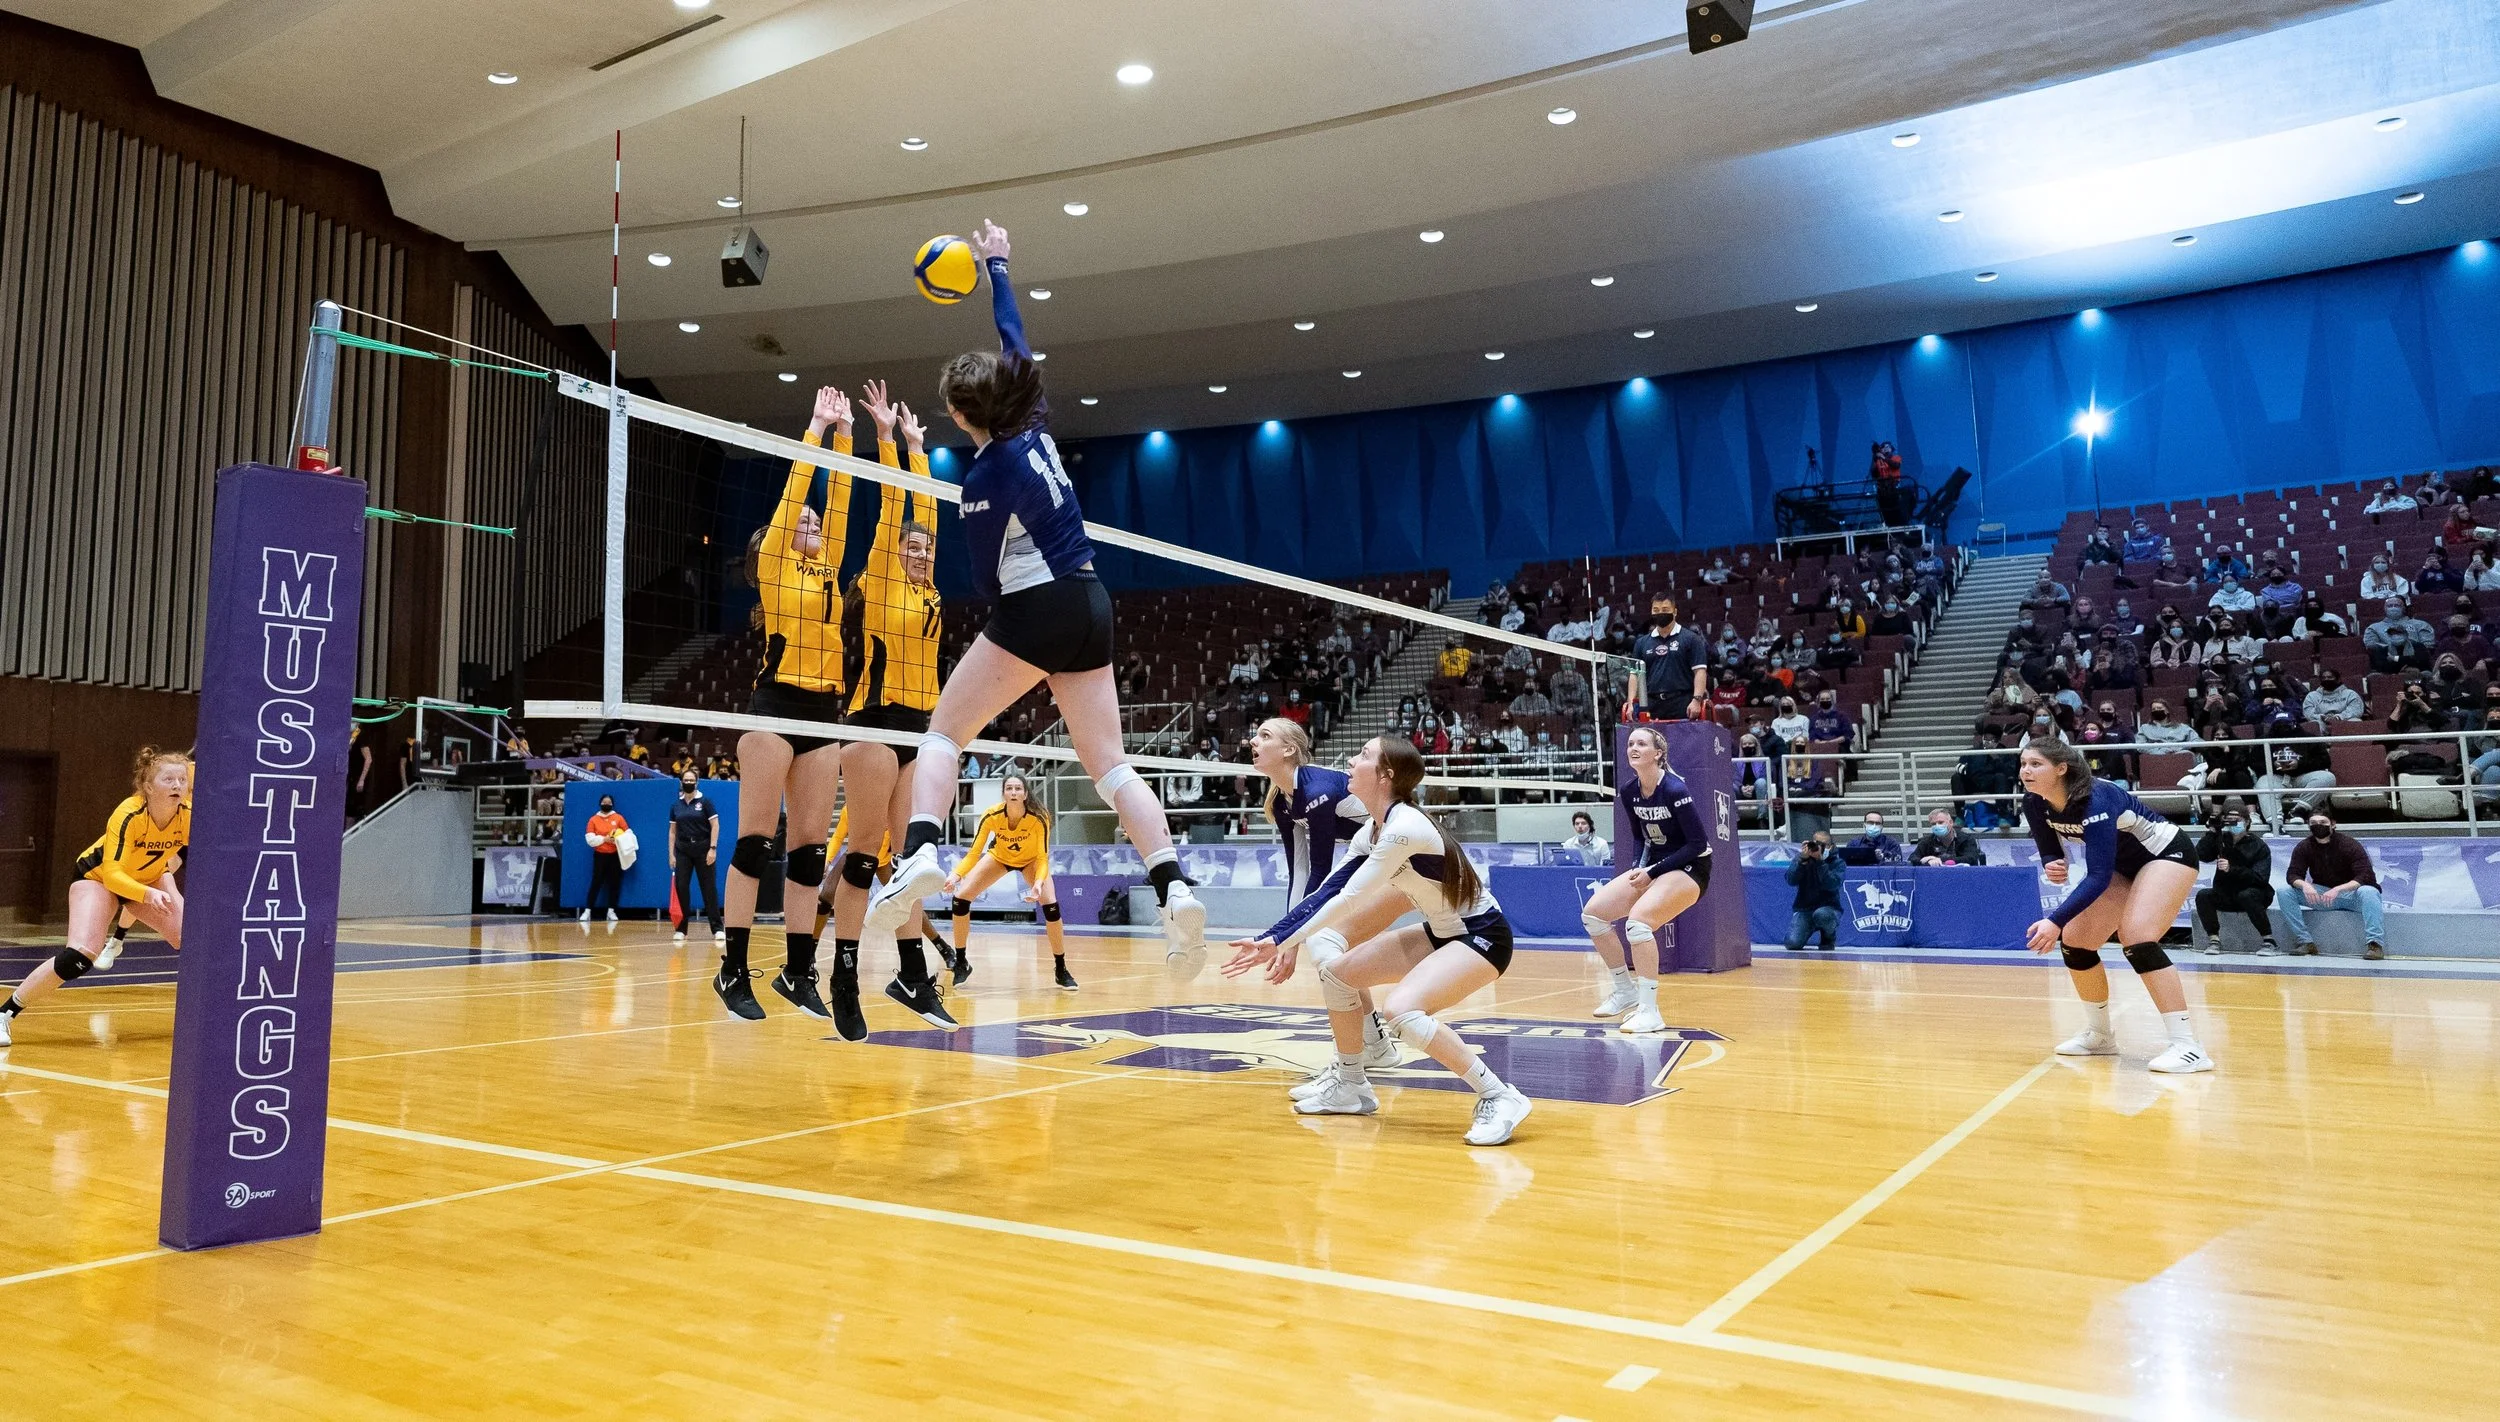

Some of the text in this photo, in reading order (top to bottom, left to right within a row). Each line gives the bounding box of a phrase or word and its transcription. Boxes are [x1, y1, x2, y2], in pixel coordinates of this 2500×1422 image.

[824, 581, 833, 624] 1
[2082, 812, 2109, 826] OUA
[136, 850, 165, 871] 7
[229, 546, 338, 1160] MUSTANGS
[1855, 915, 1909, 928] MUSTANGS
[250, 1189, 277, 1200] SPORT
